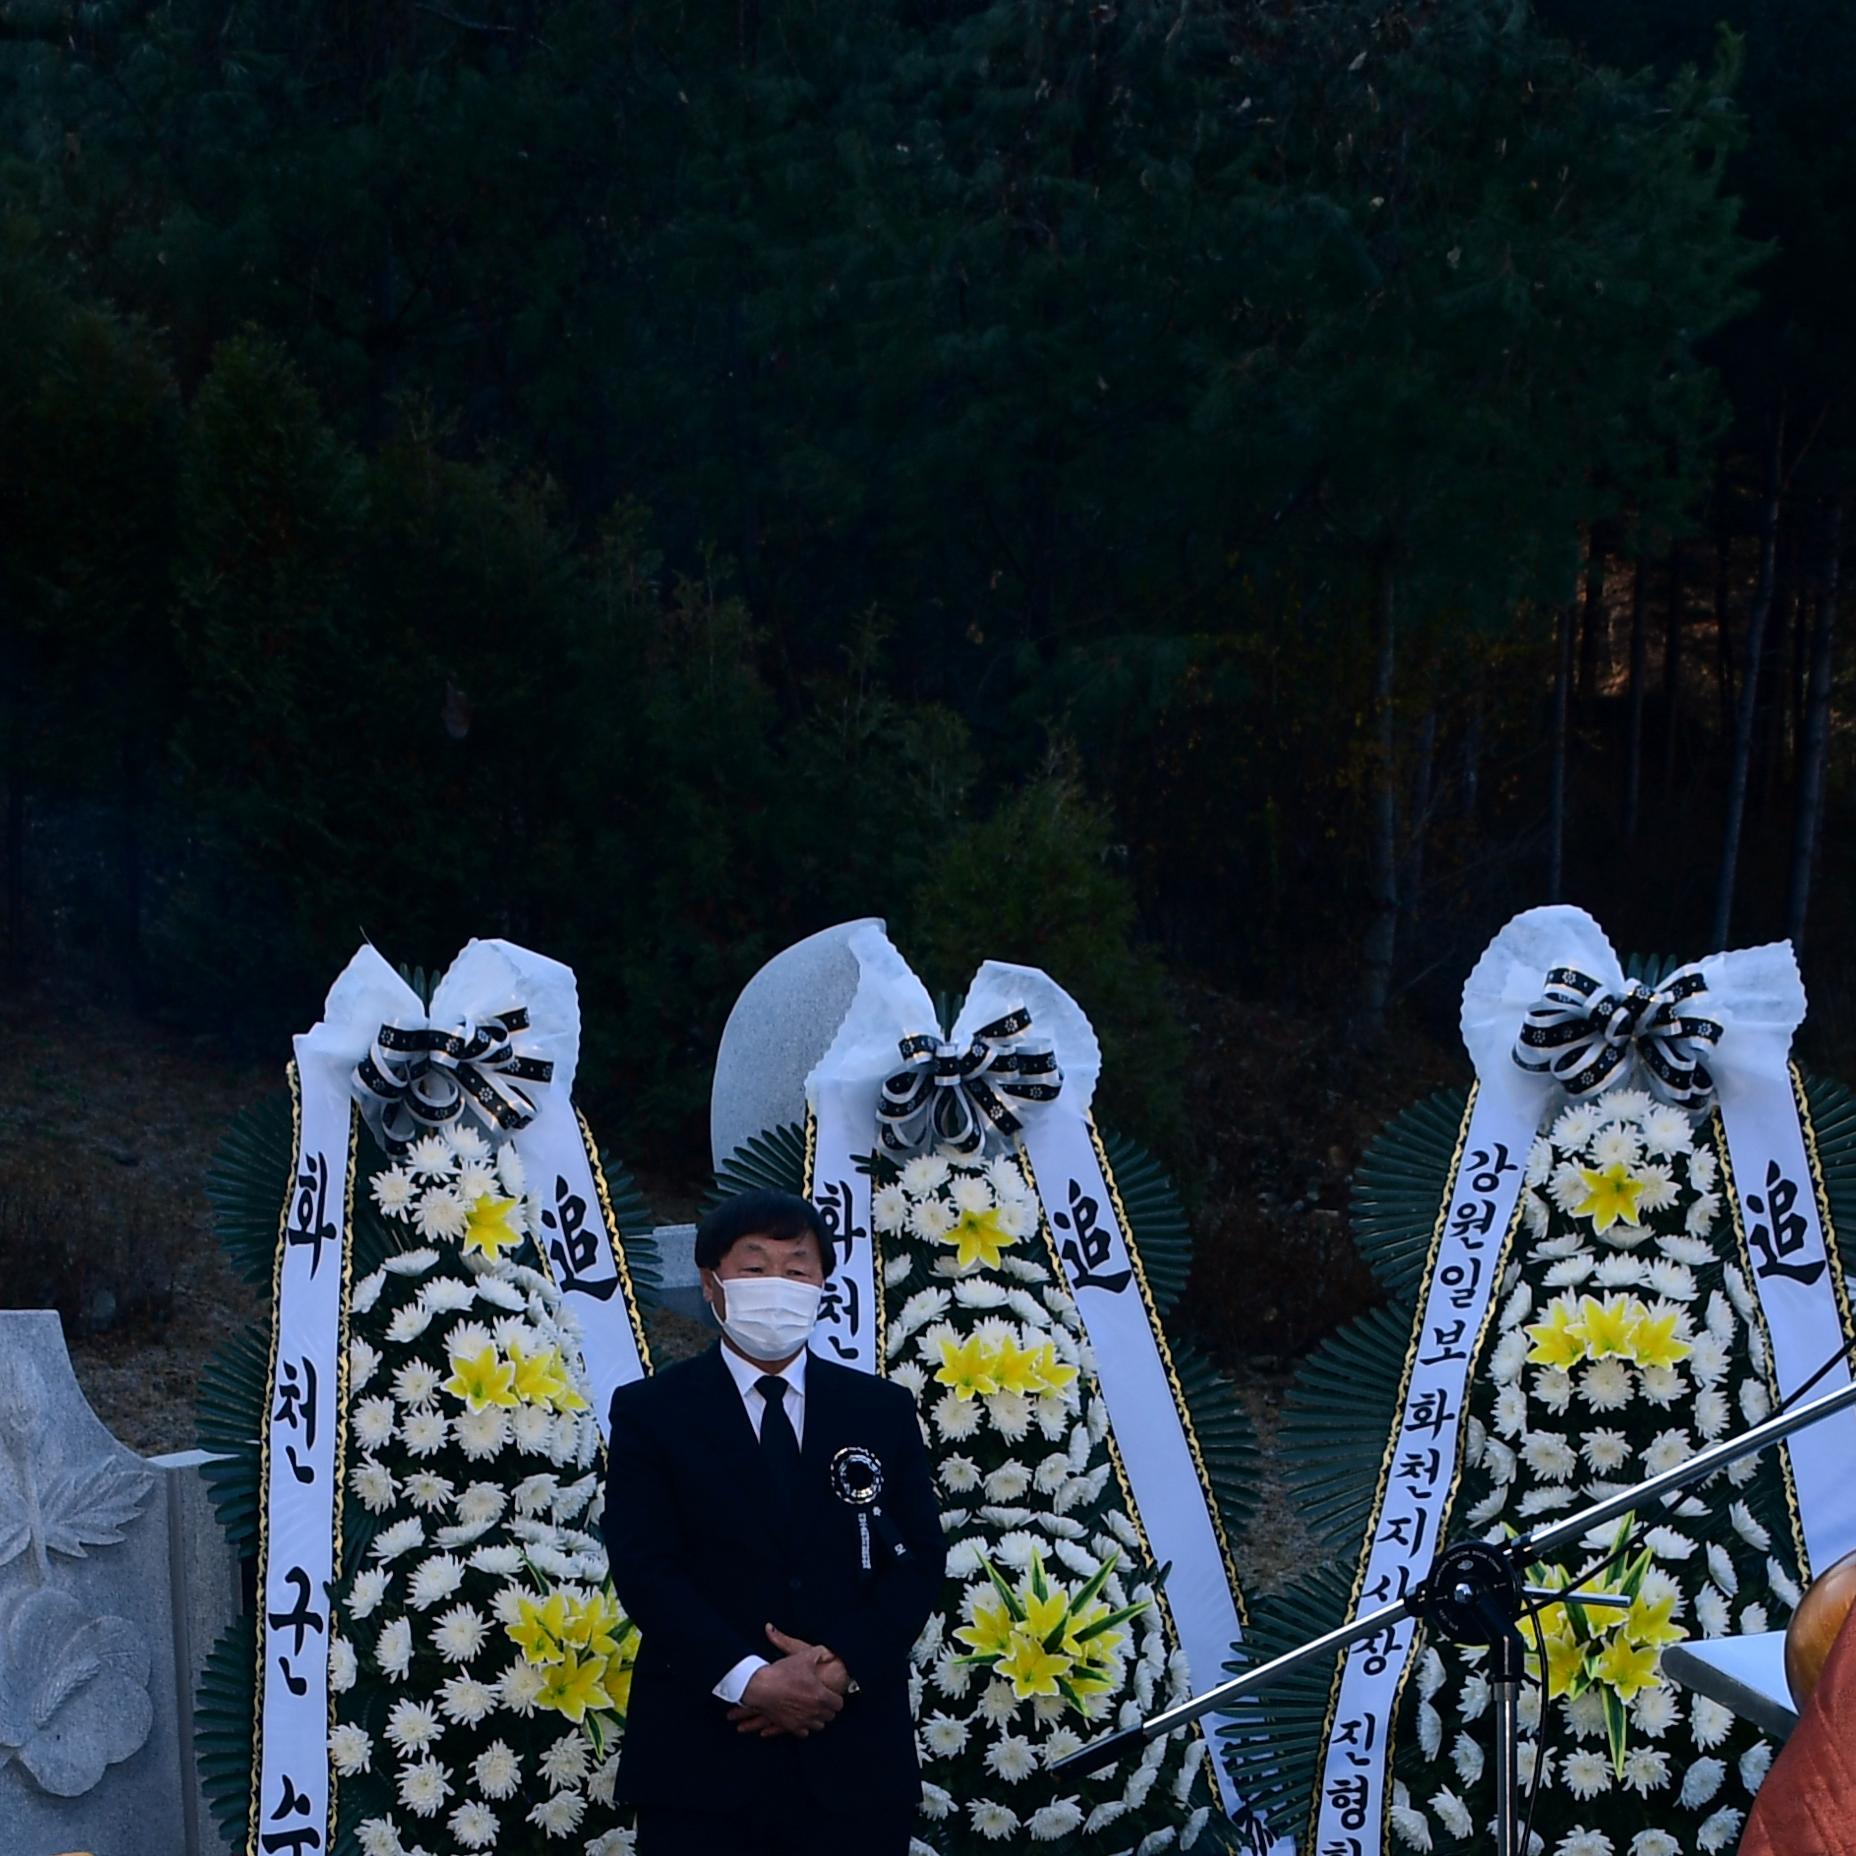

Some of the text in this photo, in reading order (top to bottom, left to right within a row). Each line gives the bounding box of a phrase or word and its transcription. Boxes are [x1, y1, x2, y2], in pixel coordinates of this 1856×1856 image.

[542, 1173, 621, 1302] 追
[1059, 1176, 1133, 1294] 追
[1418, 1141, 1518, 1369] 강원일보
[1745, 1161, 1825, 1288] 追
[1352, 1387, 1457, 1678] 화천지사장
